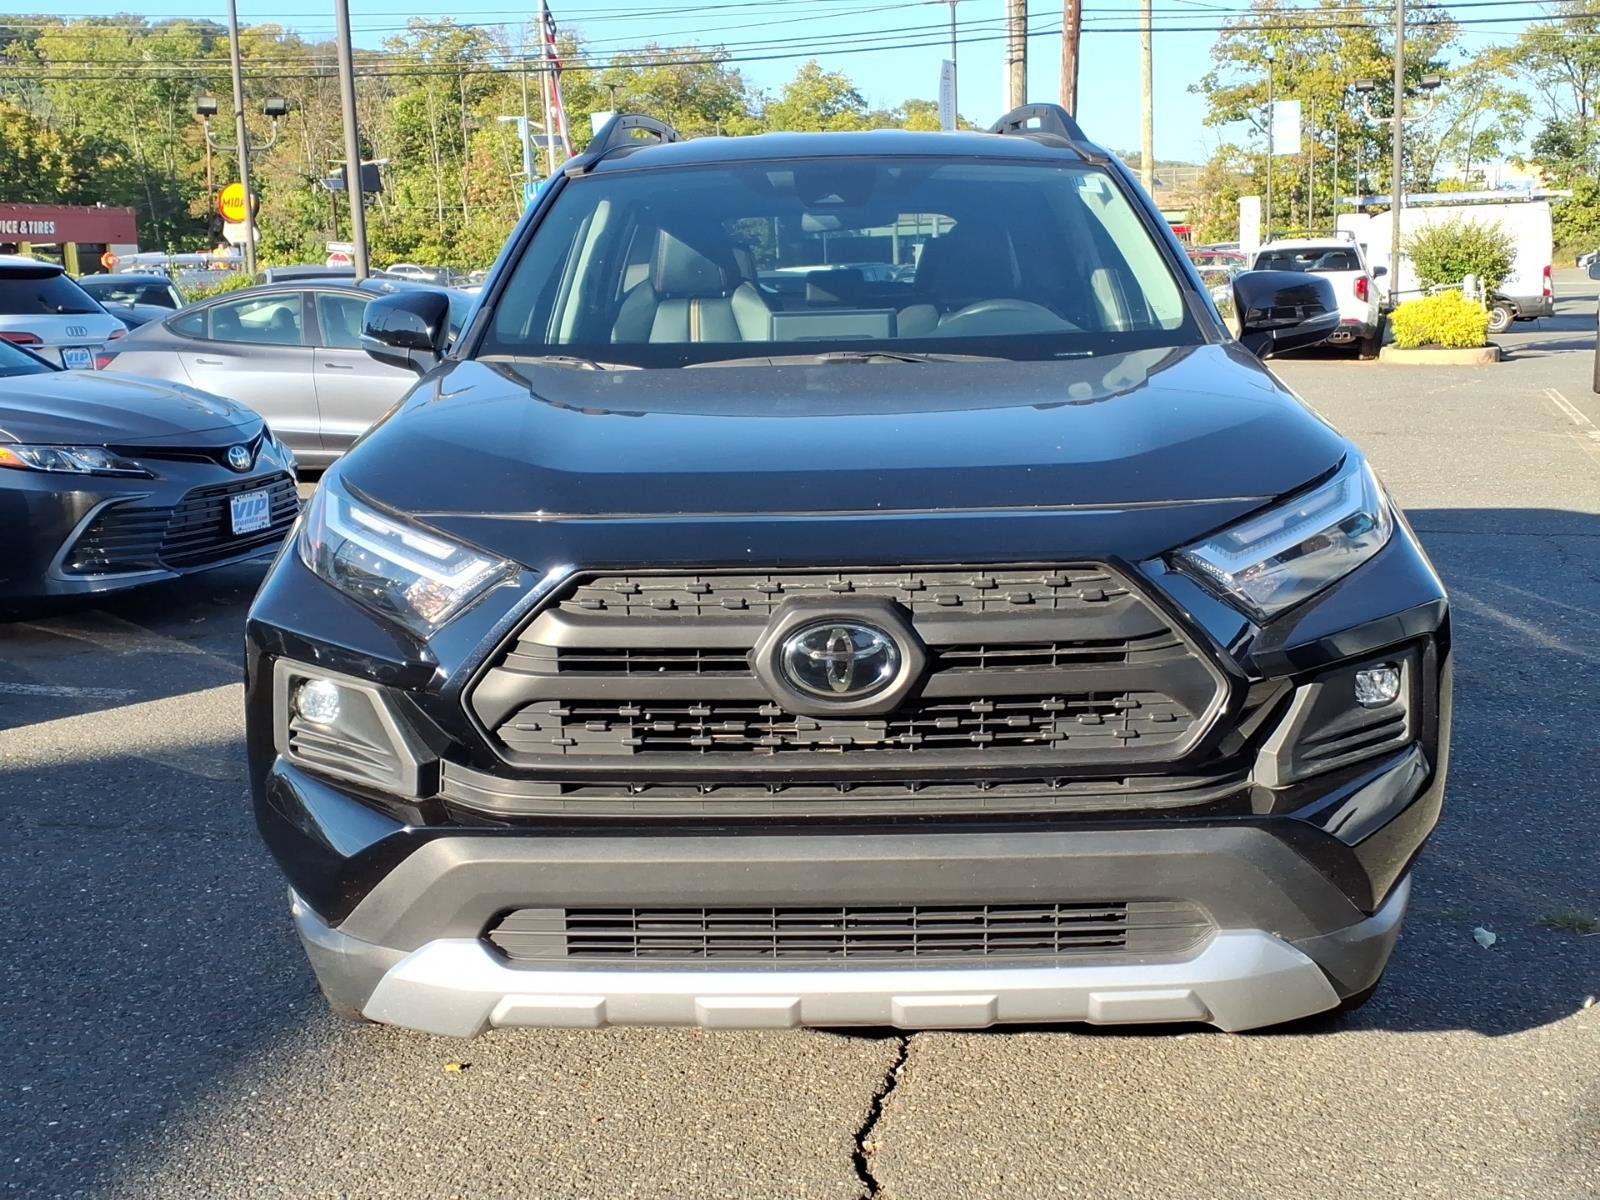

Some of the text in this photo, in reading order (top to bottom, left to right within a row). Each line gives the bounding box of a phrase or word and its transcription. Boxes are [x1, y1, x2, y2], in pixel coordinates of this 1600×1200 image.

[19, 220, 28, 234] &
[28, 221, 55, 234] TIRES
[64, 352, 88, 361] VIP
[233, 498, 267, 519] VIP
